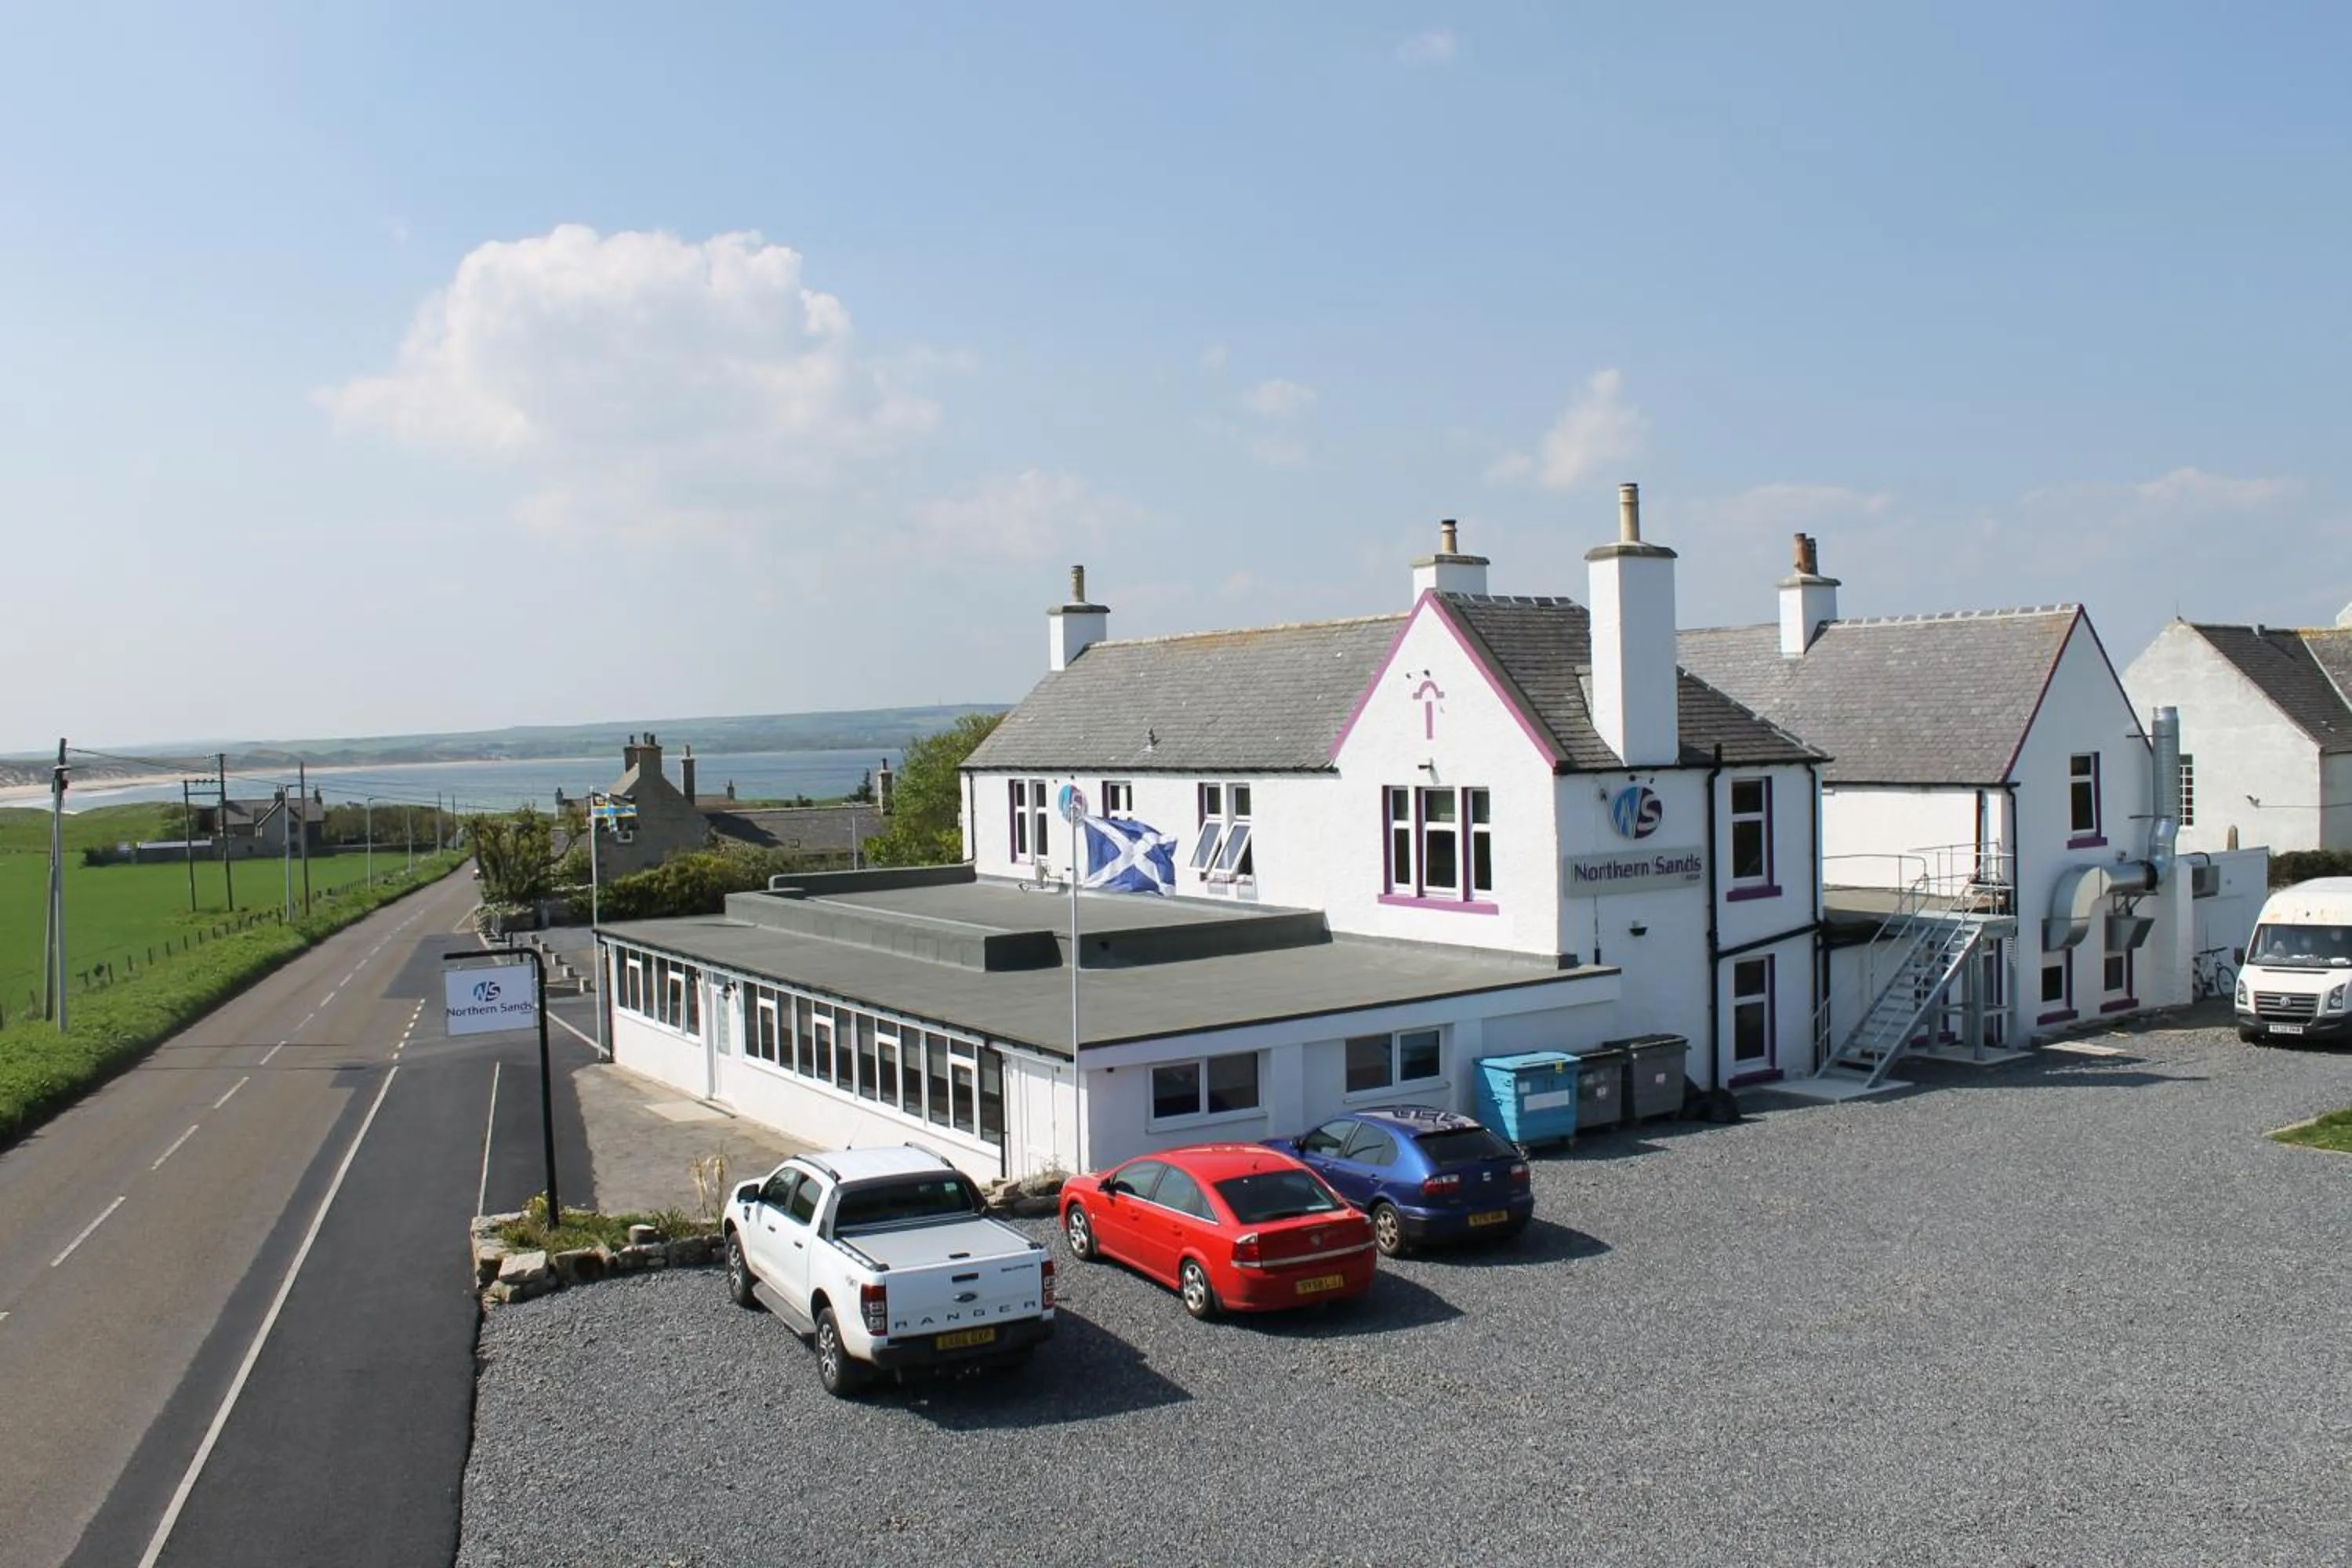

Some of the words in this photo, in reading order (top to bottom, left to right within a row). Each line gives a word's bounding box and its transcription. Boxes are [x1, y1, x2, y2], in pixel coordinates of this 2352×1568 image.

[1613, 786, 1663, 839] NS
[1573, 858, 1650, 881] Northern
[1653, 853, 1702, 875] Sands
[474, 981, 502, 1002] NS
[446, 1004, 497, 1017] Northern
[500, 1000, 533, 1013] Sands
[895, 1300, 1036, 1330] RANGER
